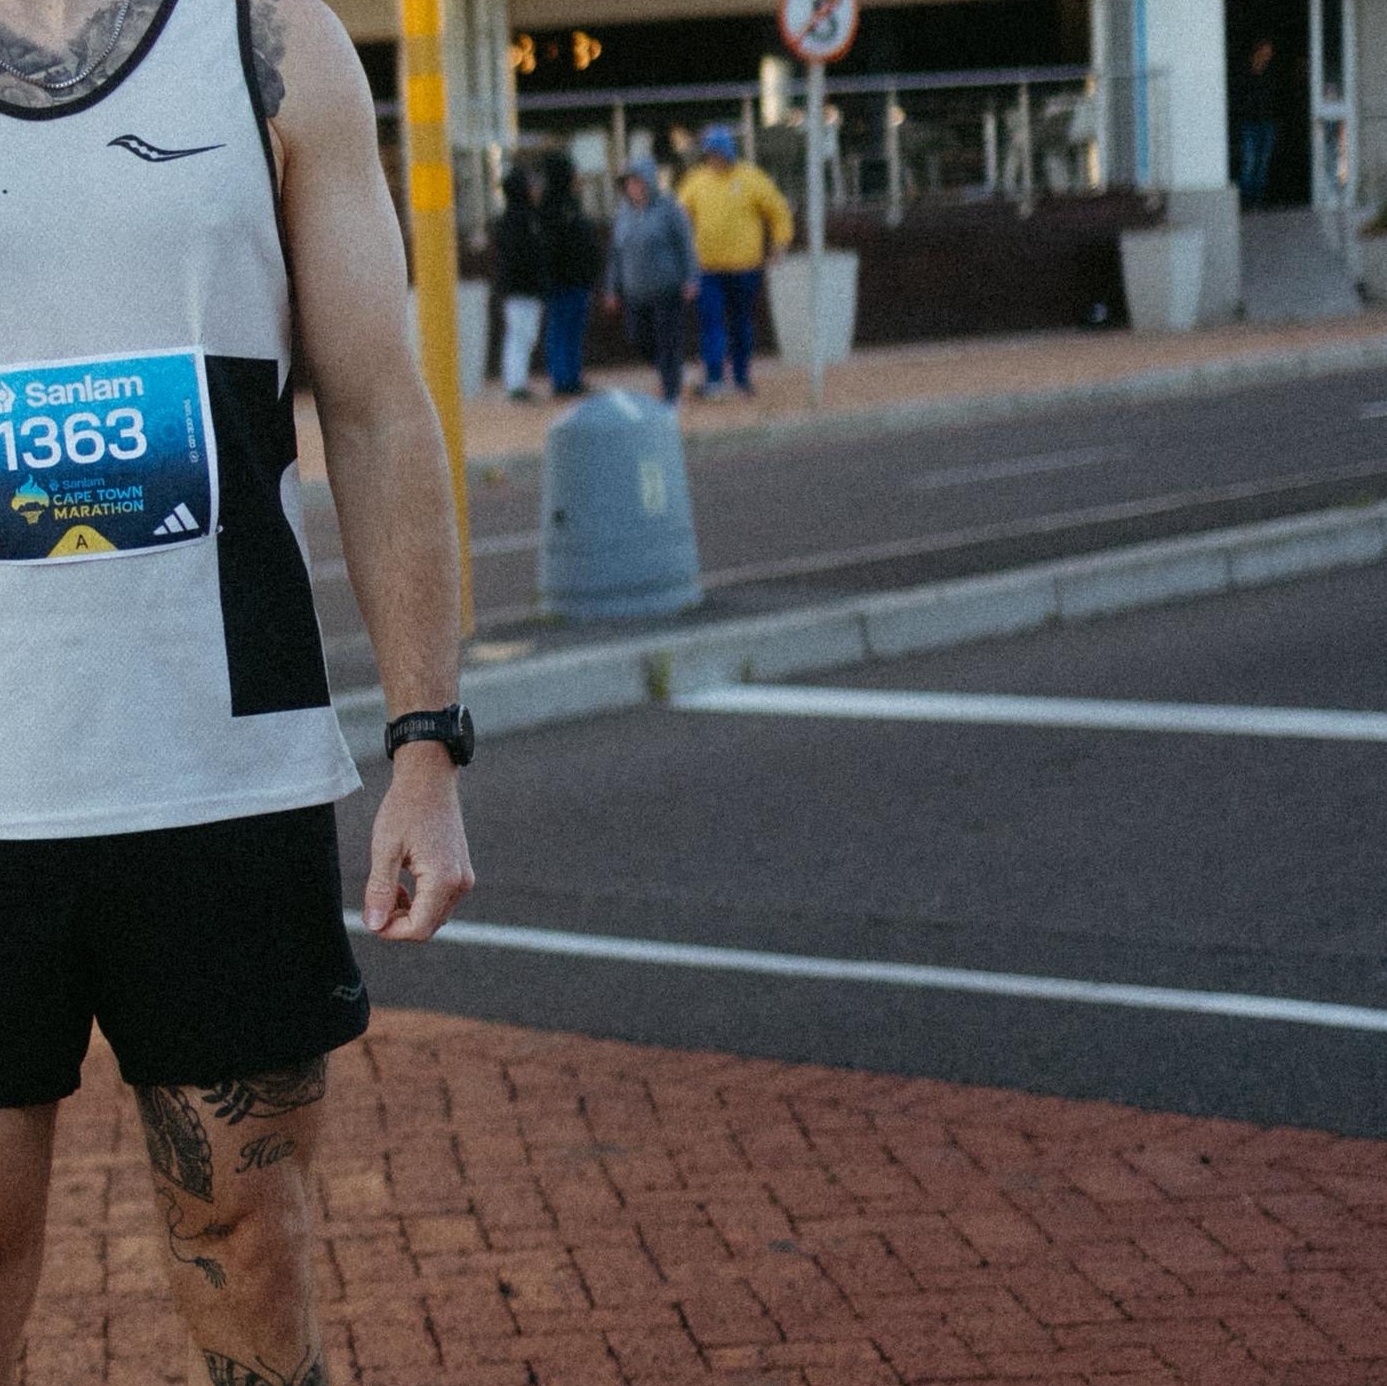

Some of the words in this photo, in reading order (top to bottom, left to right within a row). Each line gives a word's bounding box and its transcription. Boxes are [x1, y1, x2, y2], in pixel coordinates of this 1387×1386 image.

[25, 373, 144, 408] Sanlam
[62, 477, 105, 490] Sanlam
[53, 490, 93, 506] CAPE
[97, 485, 143, 501] TOWN
[54, 499, 144, 521] MARATHON
[75, 534, 89, 550] A
